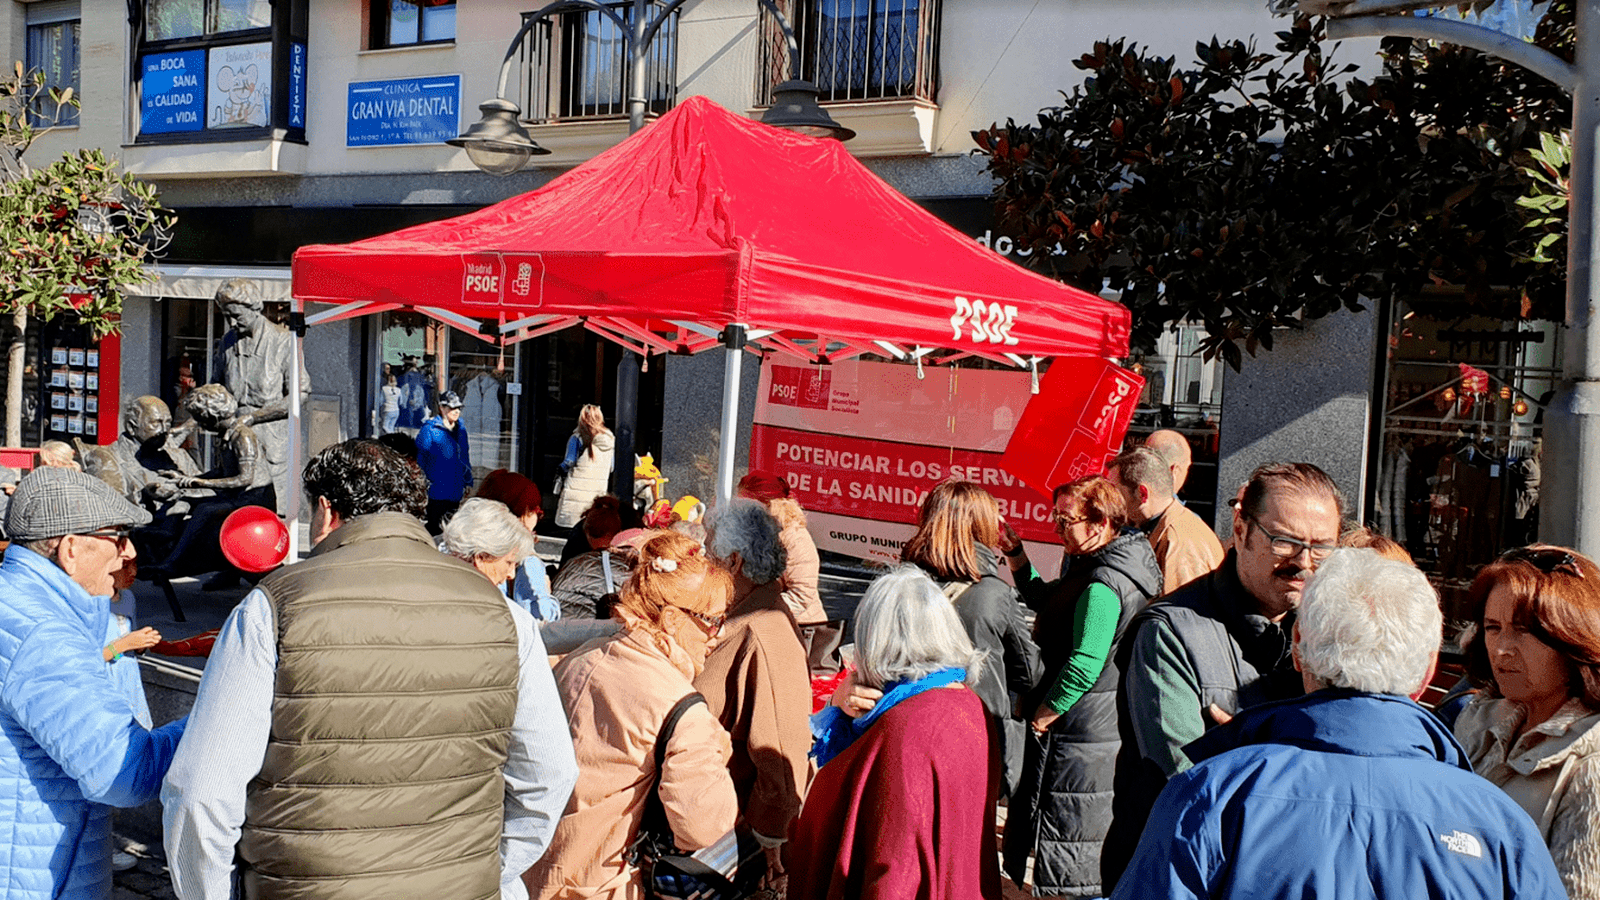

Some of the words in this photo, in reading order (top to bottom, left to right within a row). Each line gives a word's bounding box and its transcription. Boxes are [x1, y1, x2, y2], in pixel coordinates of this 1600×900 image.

[160, 57, 186, 71] BOCA
[172, 75, 198, 88] SANA
[292, 44, 302, 125] DENTISTA
[155, 93, 194, 107] CALIDAD
[352, 100, 383, 120] GRAN
[385, 99, 406, 119] VIA
[409, 96, 454, 117] DENTAL
[175, 111, 198, 124] VIDA
[466, 275, 499, 293] PSOE
[950, 296, 1019, 345] PSOE
[771, 383, 797, 399] PSOE
[776, 441, 891, 475] POTENCIAR
[896, 458, 942, 481] LOS
[786, 471, 812, 492] DE
[816, 476, 843, 497] LA
[829, 530, 868, 544] GRUPO
